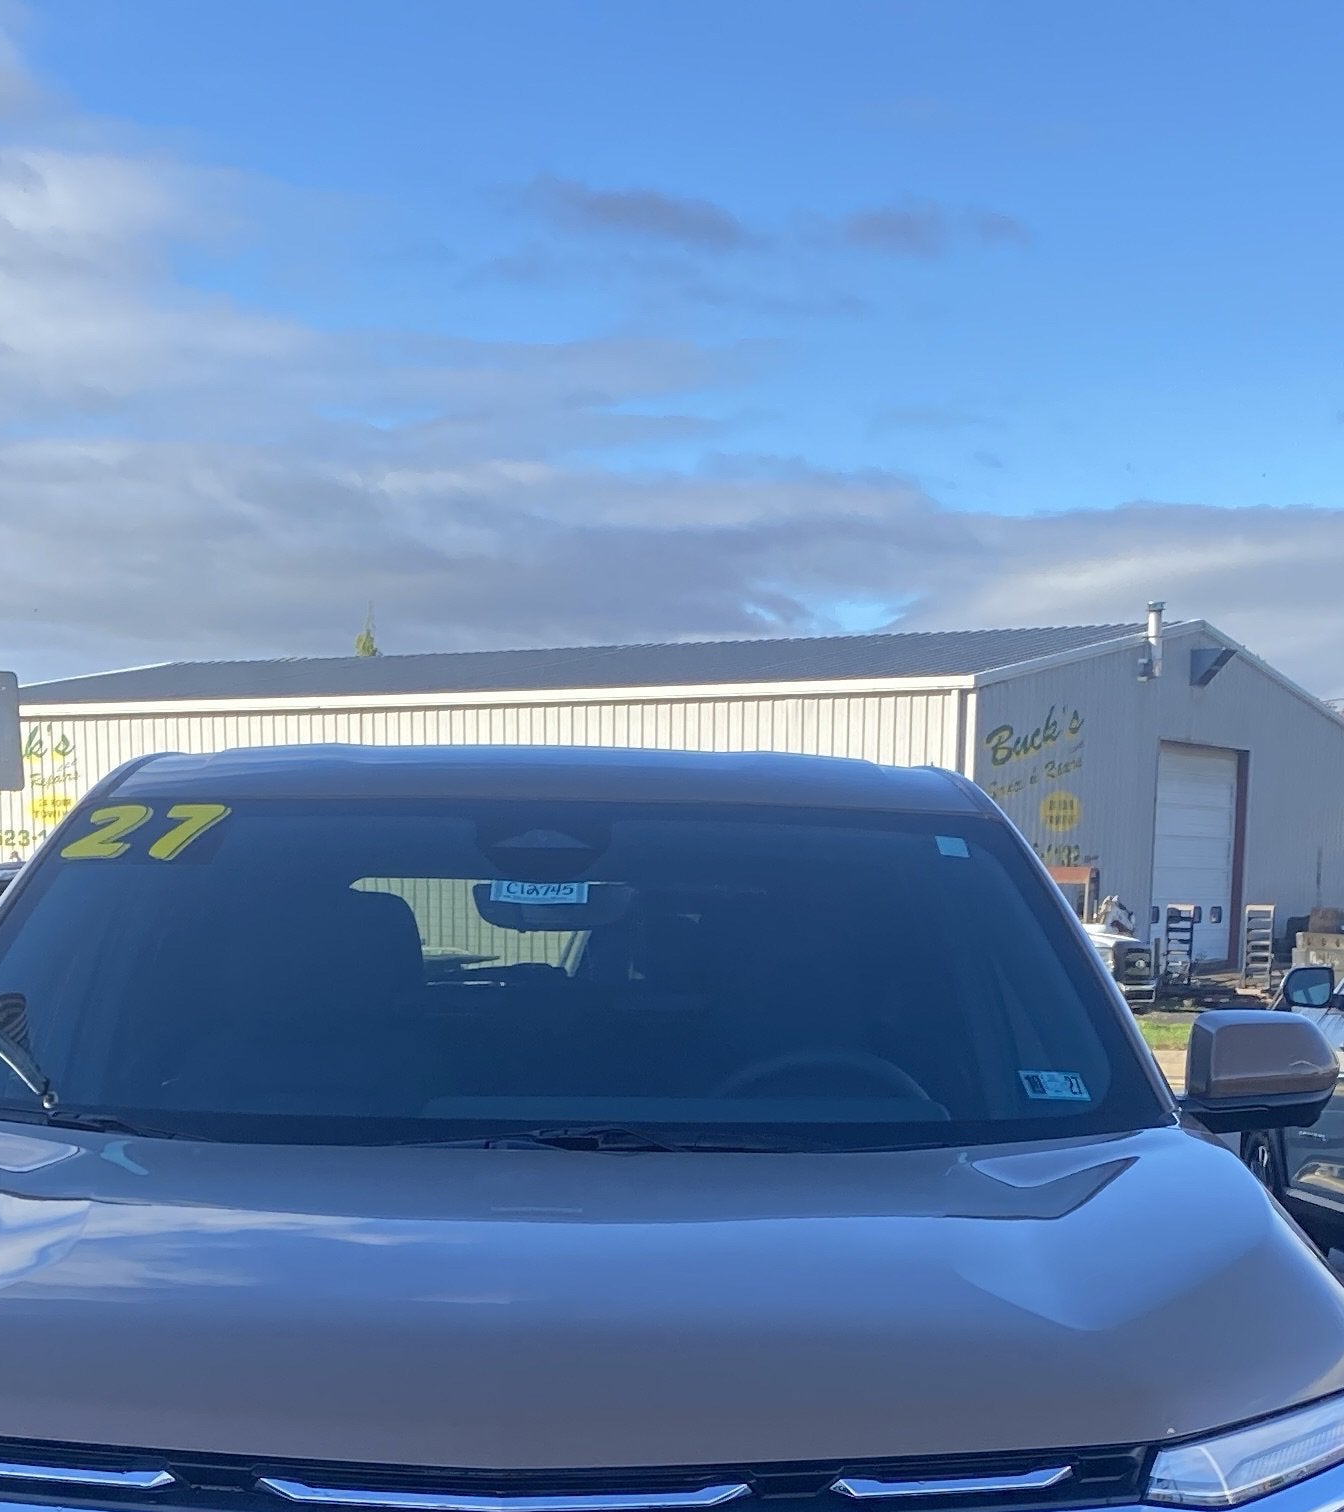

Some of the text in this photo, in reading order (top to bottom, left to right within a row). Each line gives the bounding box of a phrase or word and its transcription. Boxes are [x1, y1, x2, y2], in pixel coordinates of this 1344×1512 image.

[985, 704, 1086, 767] Buck's
[60, 803, 233, 862] 27
[506, 882, 574, 896] C12745
